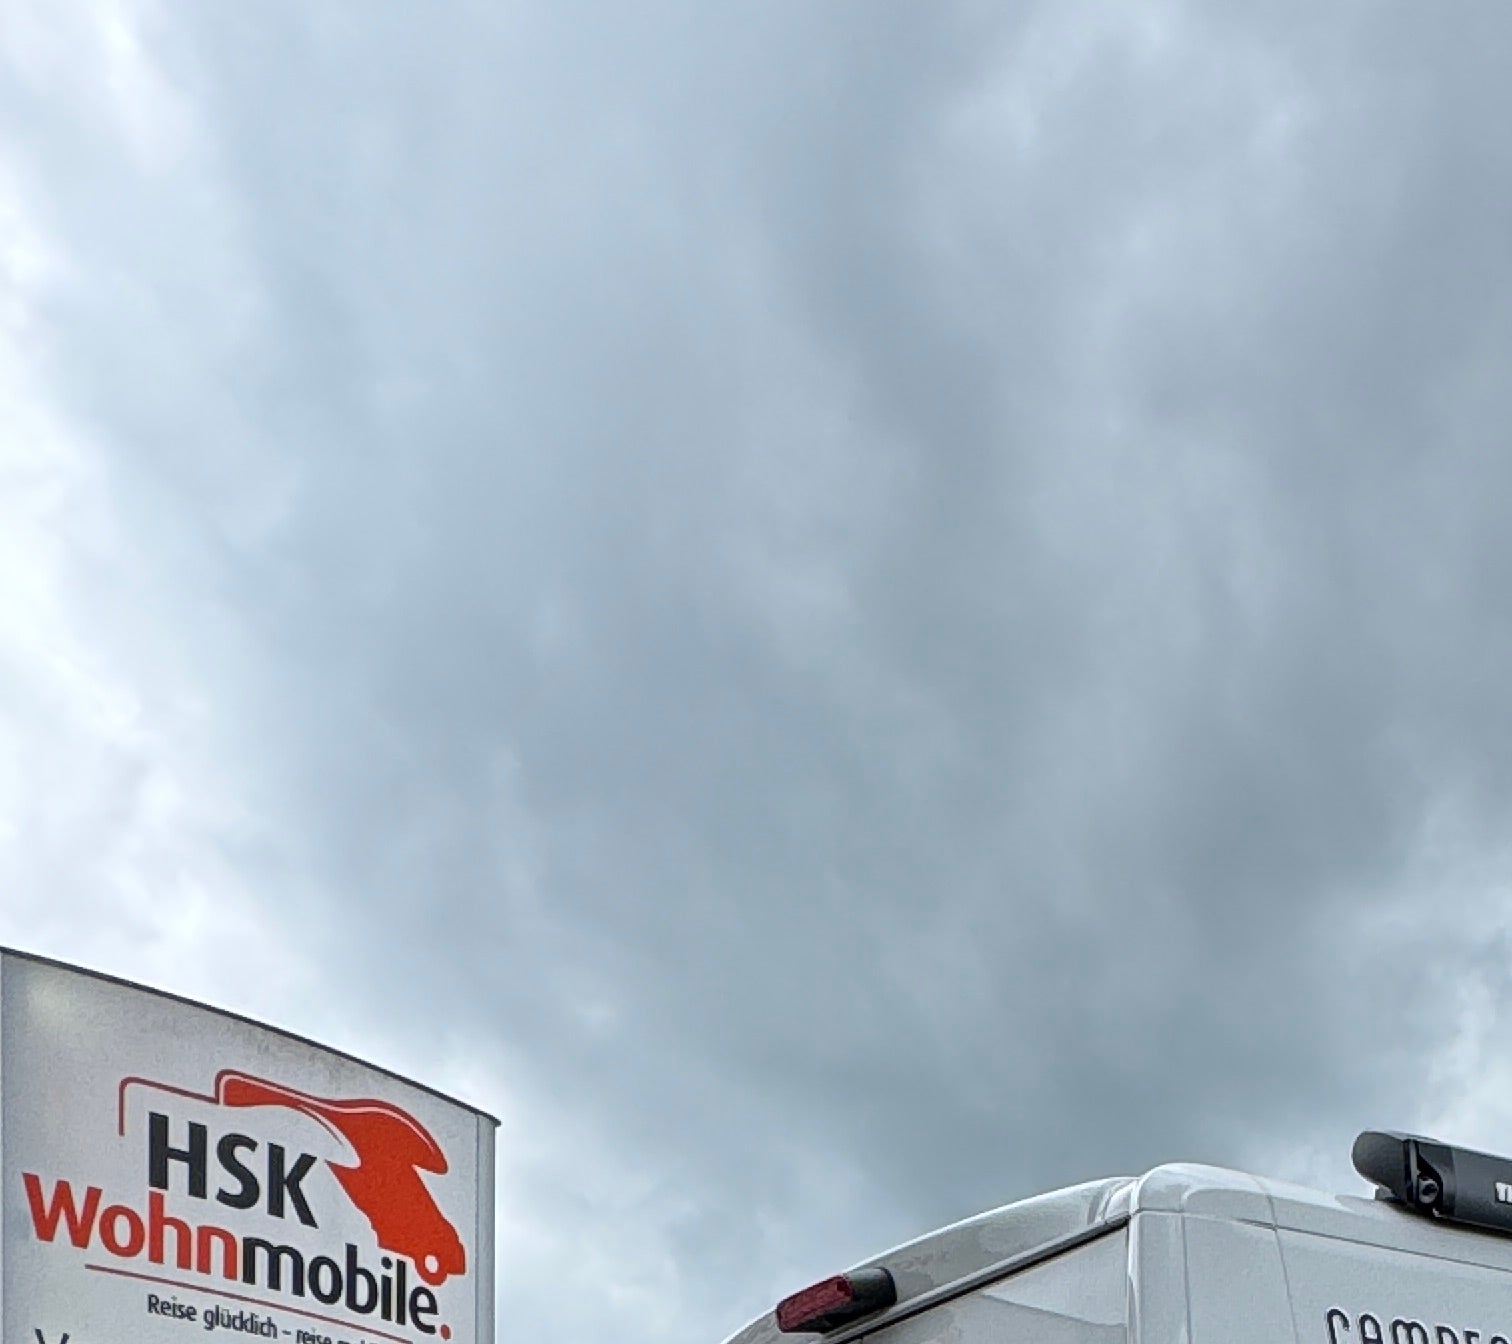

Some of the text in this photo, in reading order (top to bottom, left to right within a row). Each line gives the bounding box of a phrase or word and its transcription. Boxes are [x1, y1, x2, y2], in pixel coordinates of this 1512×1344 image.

[148, 1111, 318, 1229] HSK
[22, 1172, 452, 1340] Wohnmobile.
[147, 1294, 197, 1321] Reise
[203, 1304, 277, 1339] glücklich
